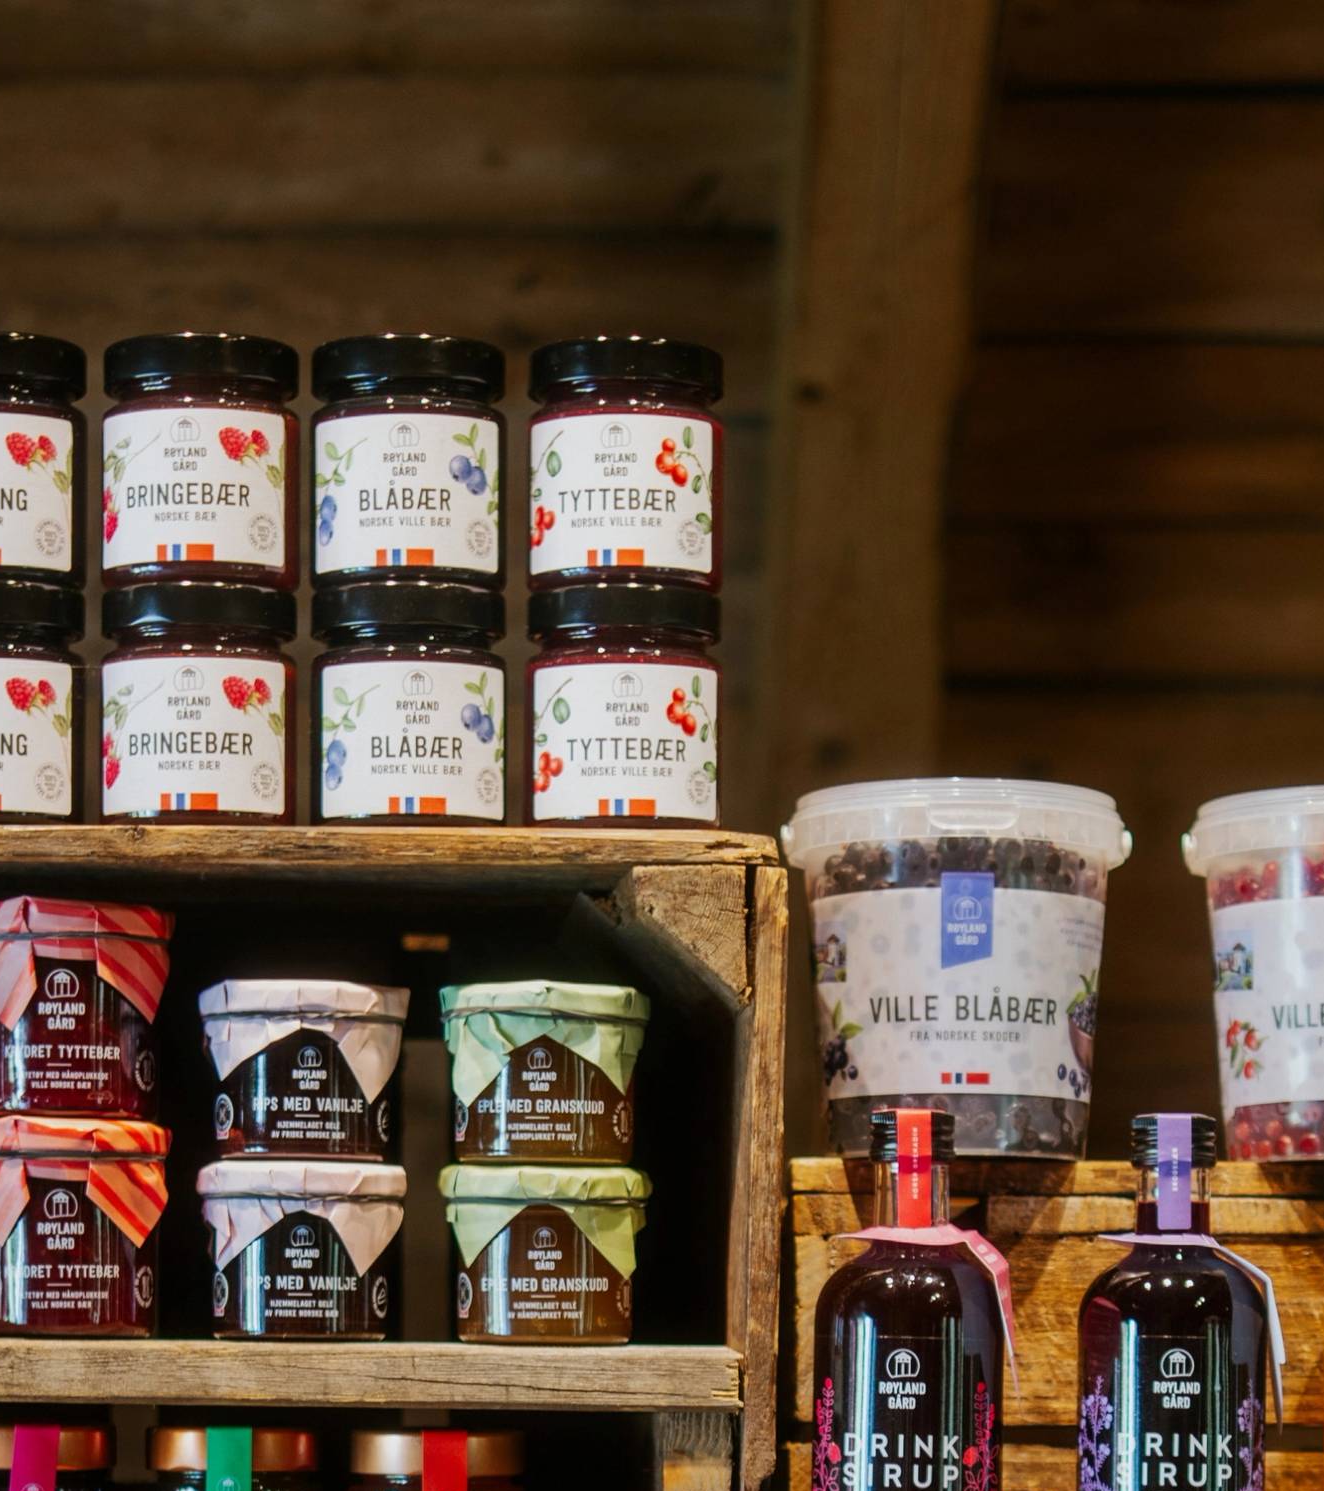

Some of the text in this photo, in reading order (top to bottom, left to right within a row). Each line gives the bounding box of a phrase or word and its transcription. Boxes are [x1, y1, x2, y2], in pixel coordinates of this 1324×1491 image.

[165, 448, 207, 458] RØYLAND
[383, 453, 426, 463] RØYLAND
[595, 453, 637, 463] RØYLAND
[173, 459, 197, 471] GÅRD
[393, 464, 417, 476] GÅRD
[604, 464, 628, 477] GÅRD
[127, 483, 250, 509] BRINGEBÆR
[360, 480, 451, 512] BLÅBÆR
[559, 489, 676, 513] TYTTEBÆR
[155, 511, 217, 522] NORSKE BÆR
[360, 516, 451, 527] NORSKE VILLE BÆR
[571, 517, 662, 528] NORSKE VILLE BÆR
[129, 732, 253, 756] BRINGEBÆR
[371, 727, 463, 759] BLÅBÆR
[567, 738, 687, 762] TYTTEBÆR
[38, 1002, 85, 1016] RØYLAND
[870, 987, 1057, 1025] VILLE BLÅBÆR
[48, 1015, 75, 1030] GÅRD
[910, 1031, 929, 1041] FRA
[936, 1031, 976, 1041] NORSKE
[58, 1045, 120, 1059] TYTTEBÆR
[284, 1097, 363, 1114] MED VANILJE
[507, 1099, 532, 1113] MED
[536, 1099, 604, 1115] GRANSKUDD
[1153, 1381, 1200, 1395] RØYLAND
[1163, 1394, 1191, 1409] GÅRD
[843, 1433, 960, 1460] DRINK
[1117, 1433, 1233, 1458] DRINK
[842, 1463, 959, 1489] SIRUP
[1116, 1462, 1233, 1487] SIRUP
